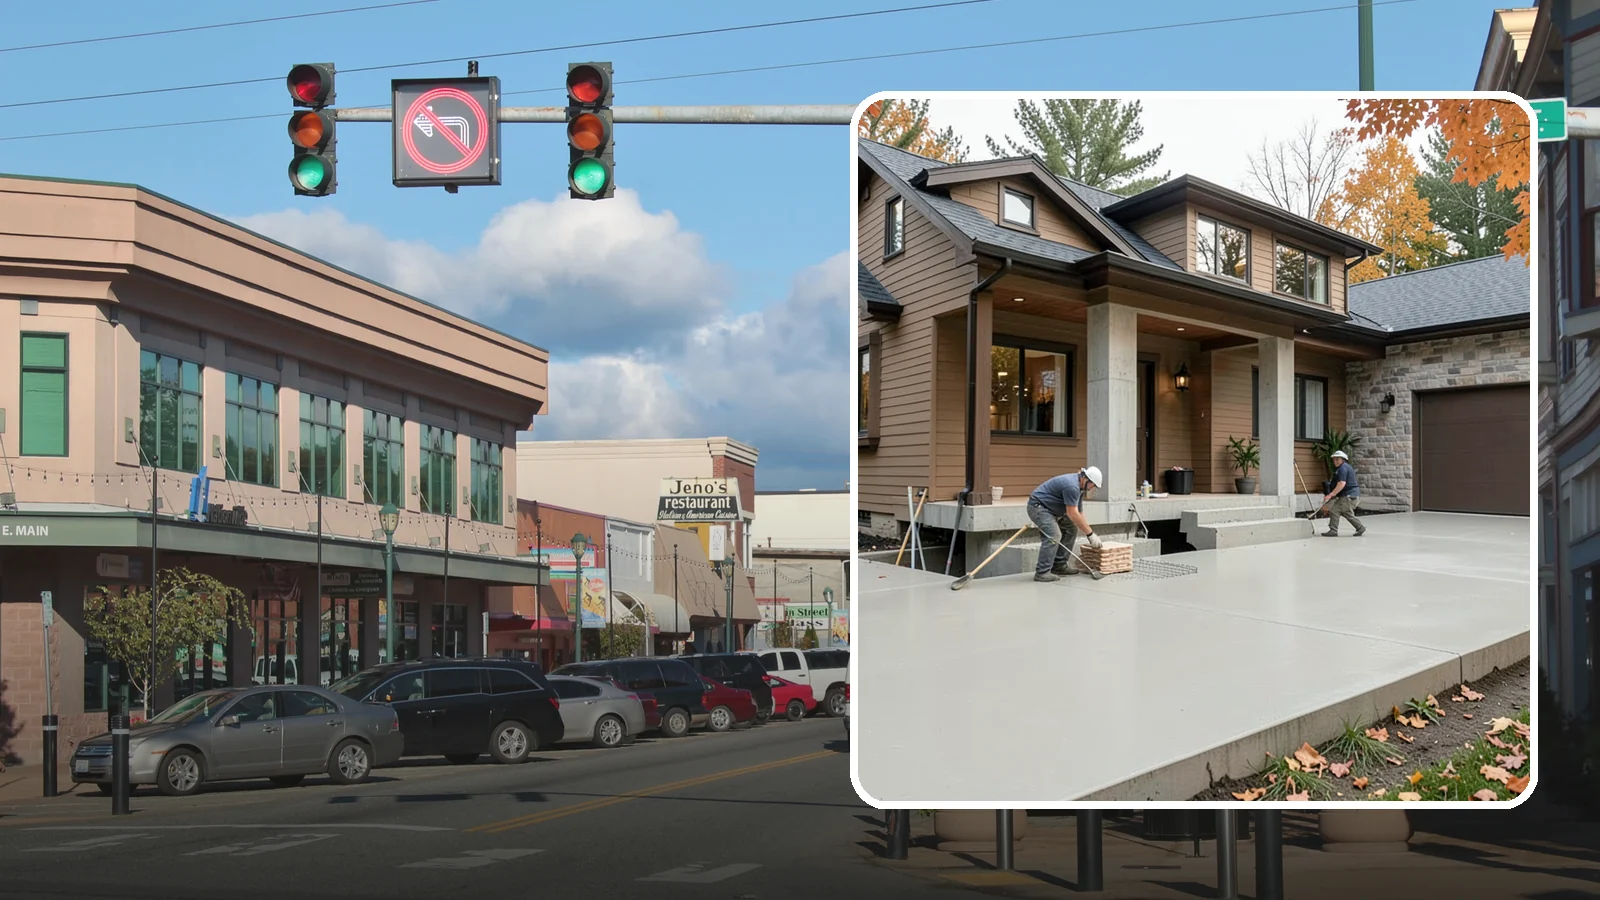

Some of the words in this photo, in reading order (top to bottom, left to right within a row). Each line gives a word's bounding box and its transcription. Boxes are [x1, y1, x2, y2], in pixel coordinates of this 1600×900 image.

[670, 480, 727, 494] Jeno's
[665, 496, 731, 509] restaurant
[659, 510, 681, 519] Italian
[686, 509, 714, 519] American
[715, 509, 737, 519] Cuisine
[2, 525, 13, 536] E.
[15, 525, 49, 536] MAIN
[785, 607, 795, 617] in
[797, 607, 829, 617] Street
[790, 619, 824, 627] lass
